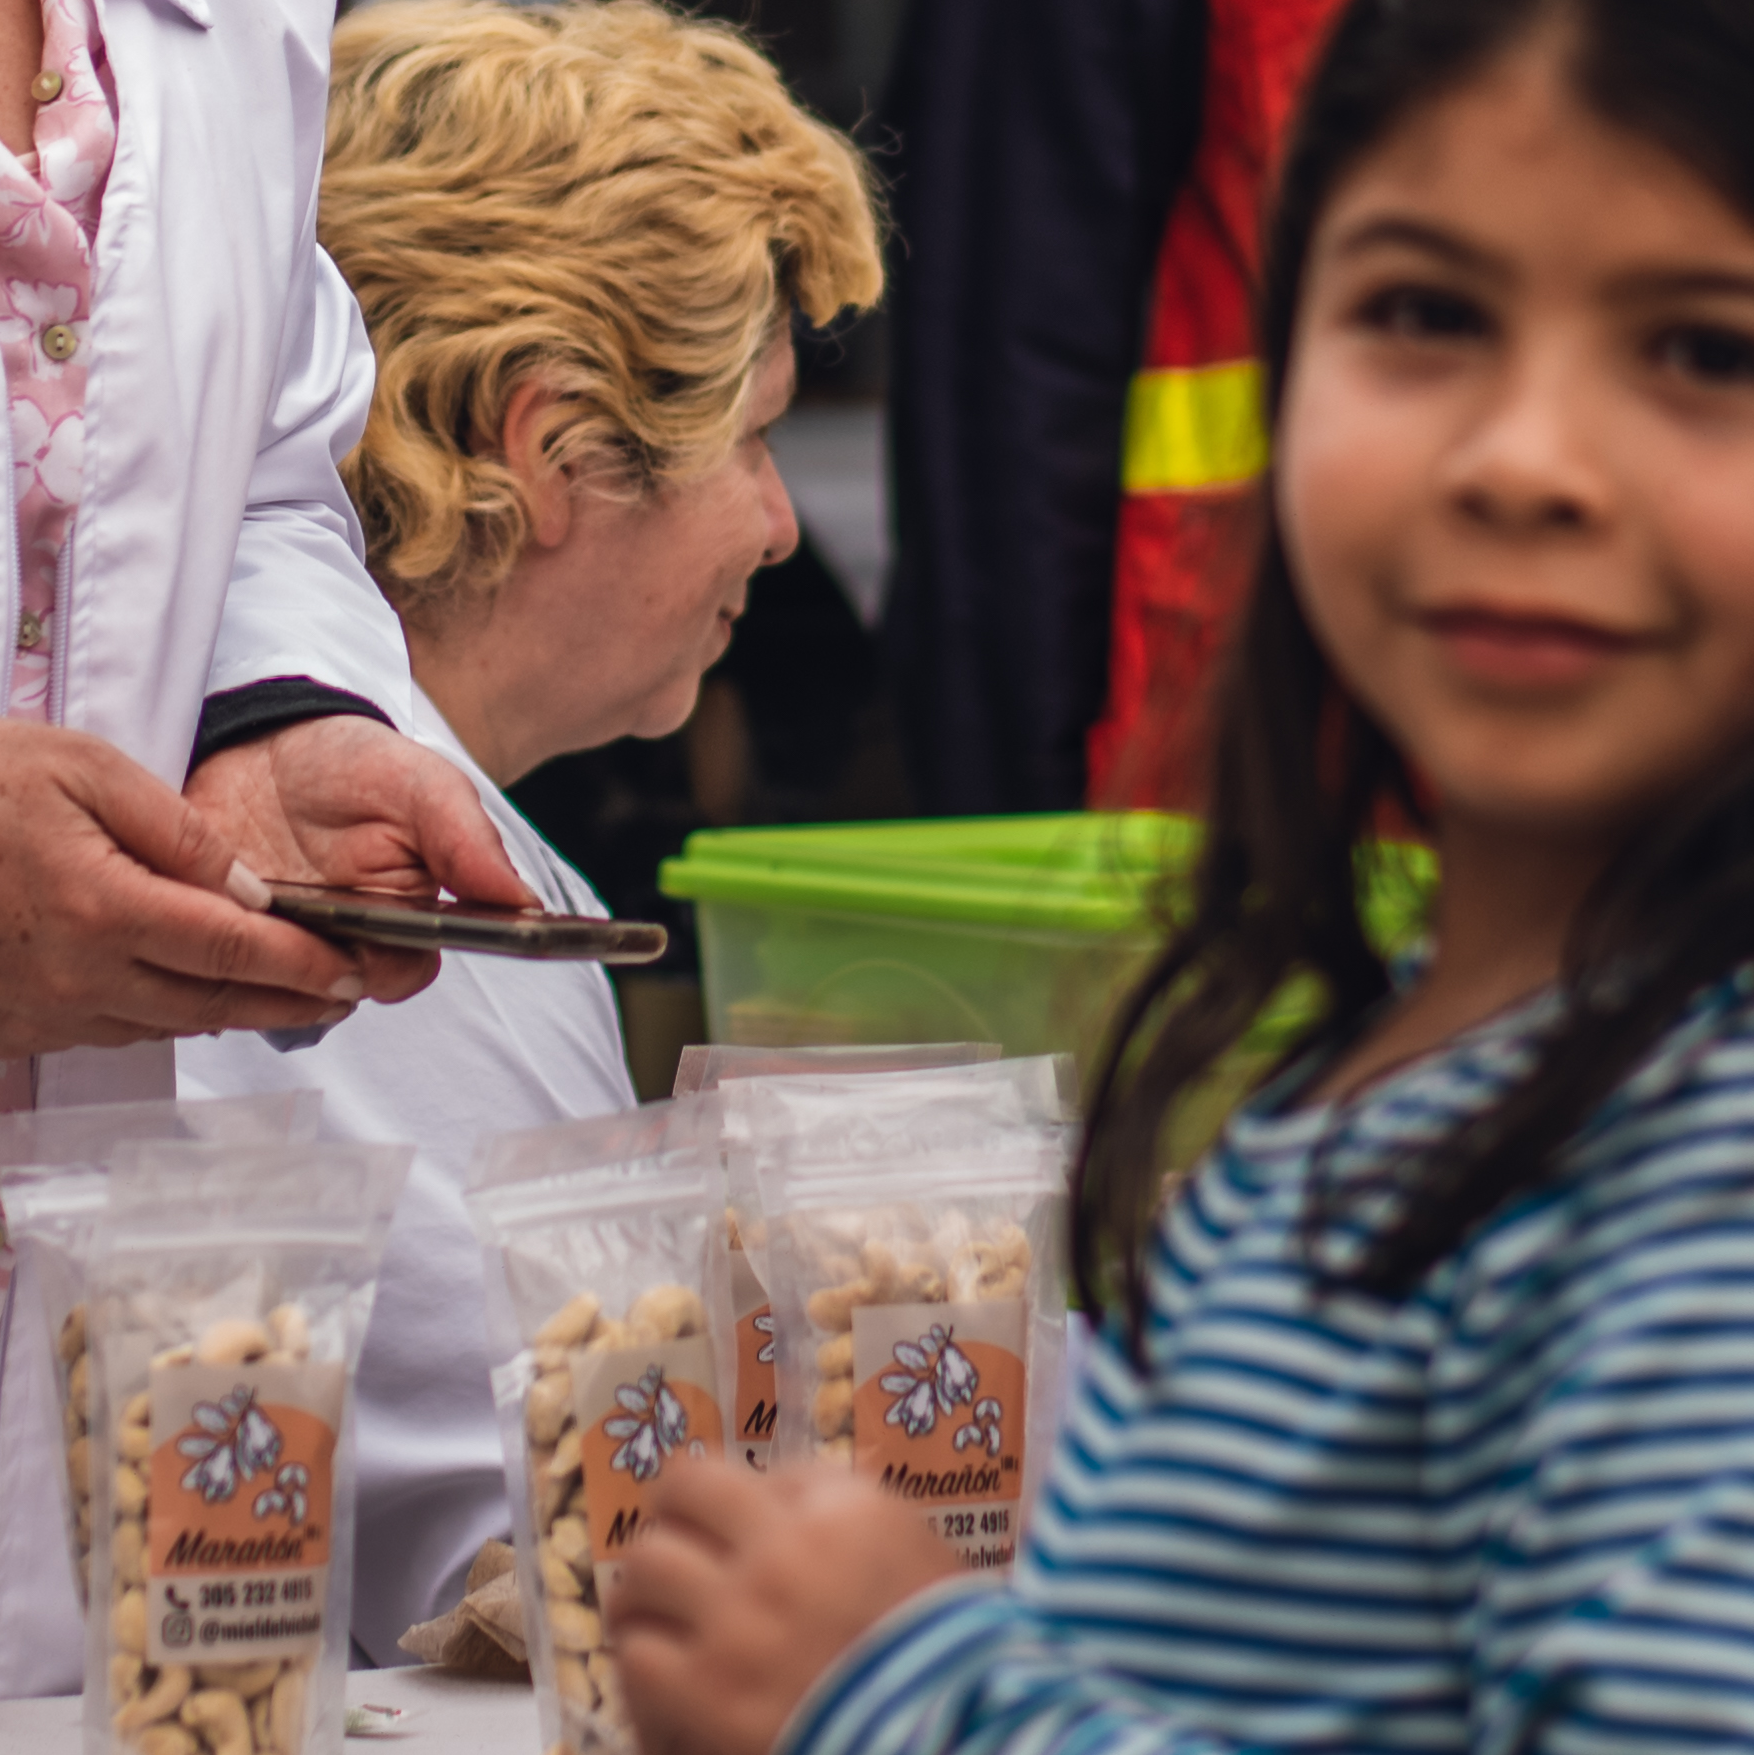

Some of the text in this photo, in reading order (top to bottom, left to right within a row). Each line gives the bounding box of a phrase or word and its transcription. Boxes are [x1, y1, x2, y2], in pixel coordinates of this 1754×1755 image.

[879, 1463, 1001, 1498] Marañón
[944, 1512, 975, 1537] 232
[980, 1509, 1009, 1535] 4915
[164, 1527, 305, 1568] Marañón
[200, 1580, 237, 1609] 305
[243, 1579, 276, 1606] 232
